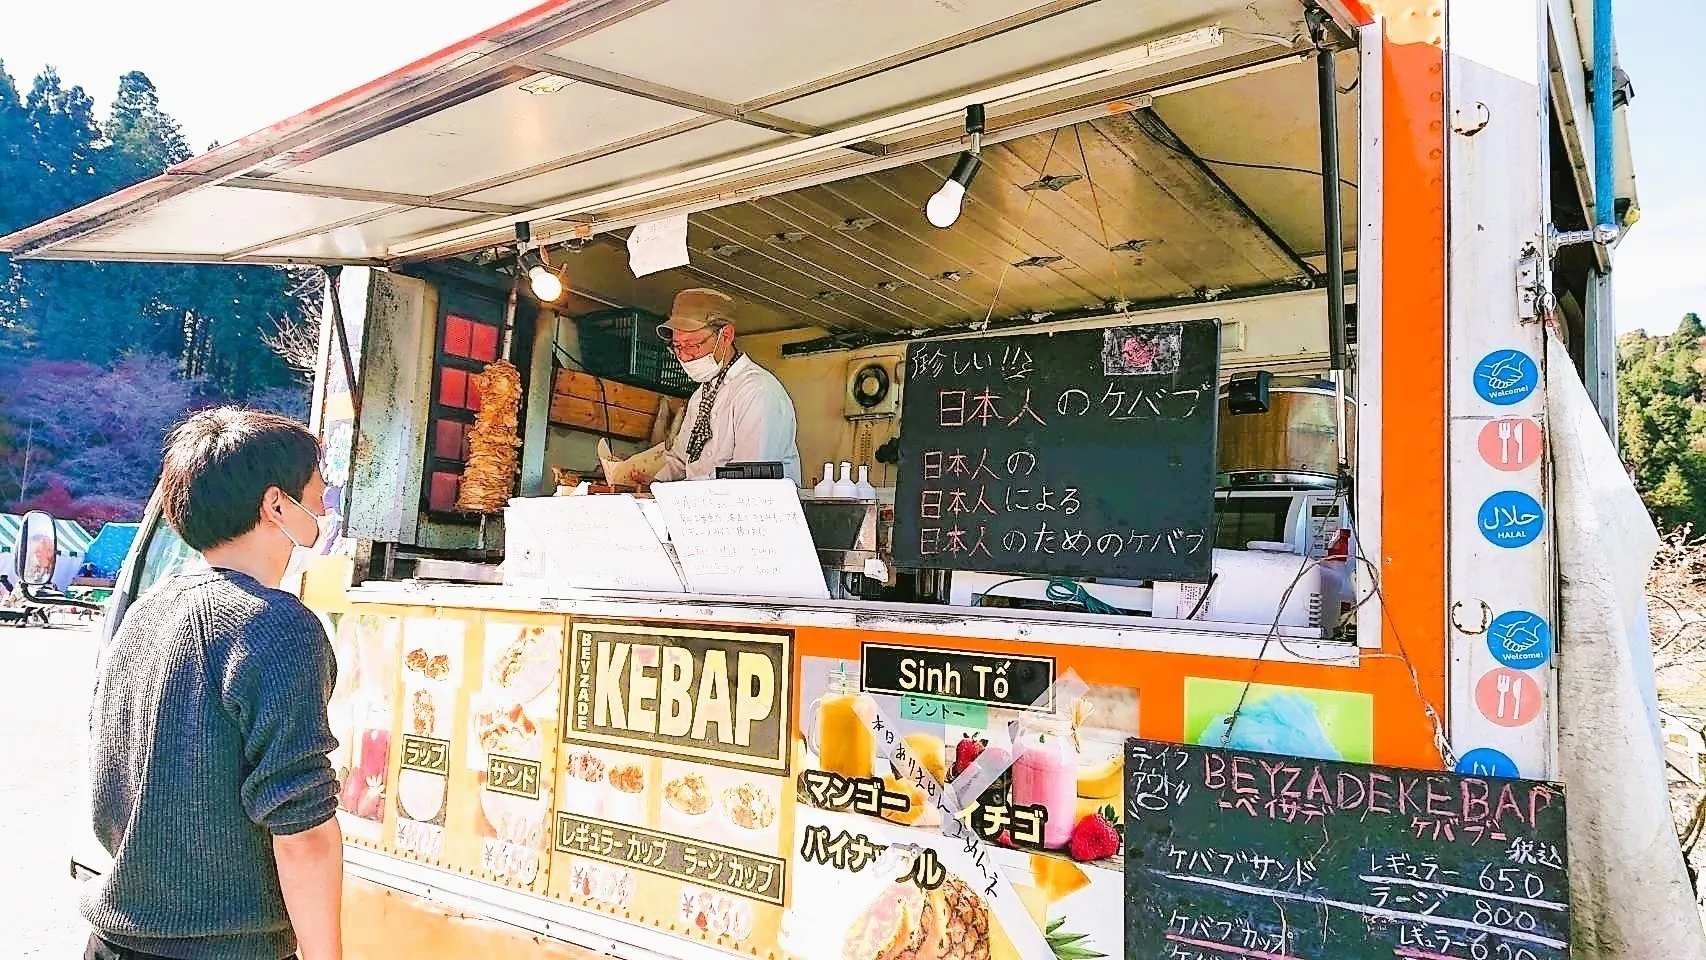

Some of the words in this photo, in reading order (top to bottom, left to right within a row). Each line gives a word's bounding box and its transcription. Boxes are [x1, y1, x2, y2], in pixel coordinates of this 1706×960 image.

[1489, 385, 1529, 399] Welcome!
[1484, 505, 1540, 530] حلال
[1497, 530, 1527, 539] HALAL
[1502, 651, 1544, 661] Welcome!
[577, 633, 593, 729] BEYZADE
[594, 641, 775, 746] KEBAP
[899, 659, 962, 695] Sinh
[973, 660, 1011, 699] Tố
[910, 699, 966, 719] シントー
[491, 760, 536, 792] サンド
[804, 770, 910, 816] マンゴー
[954, 802, 1047, 847] イチゴ
[802, 825, 946, 889] パイナプル
[1169, 845, 1317, 886] ケバブサンド
[1505, 836, 1562, 869] 税込
[1371, 853, 1459, 880] レギュラー
[1479, 862, 1544, 899] 650
[1370, 887, 1449, 915] ラージ
[1473, 899, 1536, 931] 800
[1168, 909, 1294, 953] ケバブカップ
[1401, 924, 1468, 953] レギュラー
